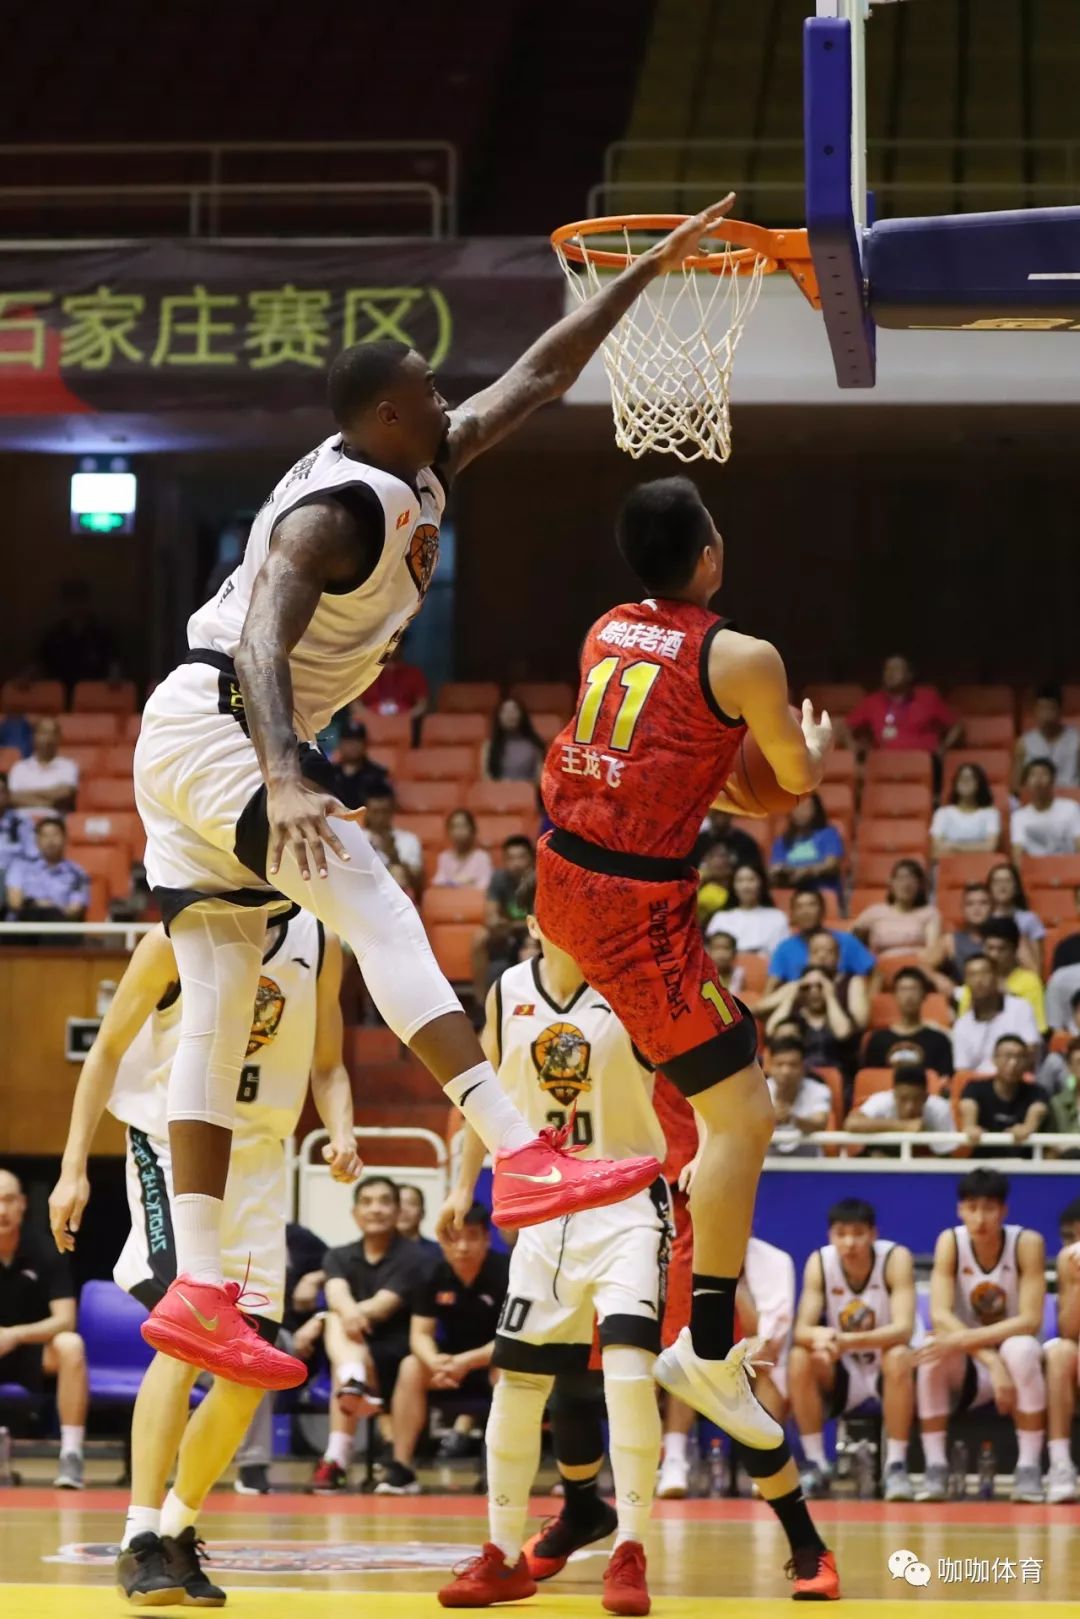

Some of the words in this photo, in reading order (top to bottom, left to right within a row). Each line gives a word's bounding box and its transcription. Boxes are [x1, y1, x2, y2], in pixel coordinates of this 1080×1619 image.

[0, 284, 453, 372] 石家庄赛区)
[574, 656, 661, 752] 11
[561, 745, 626, 789] 王龙飞
[146, 1197, 167, 1254] SHOCK
